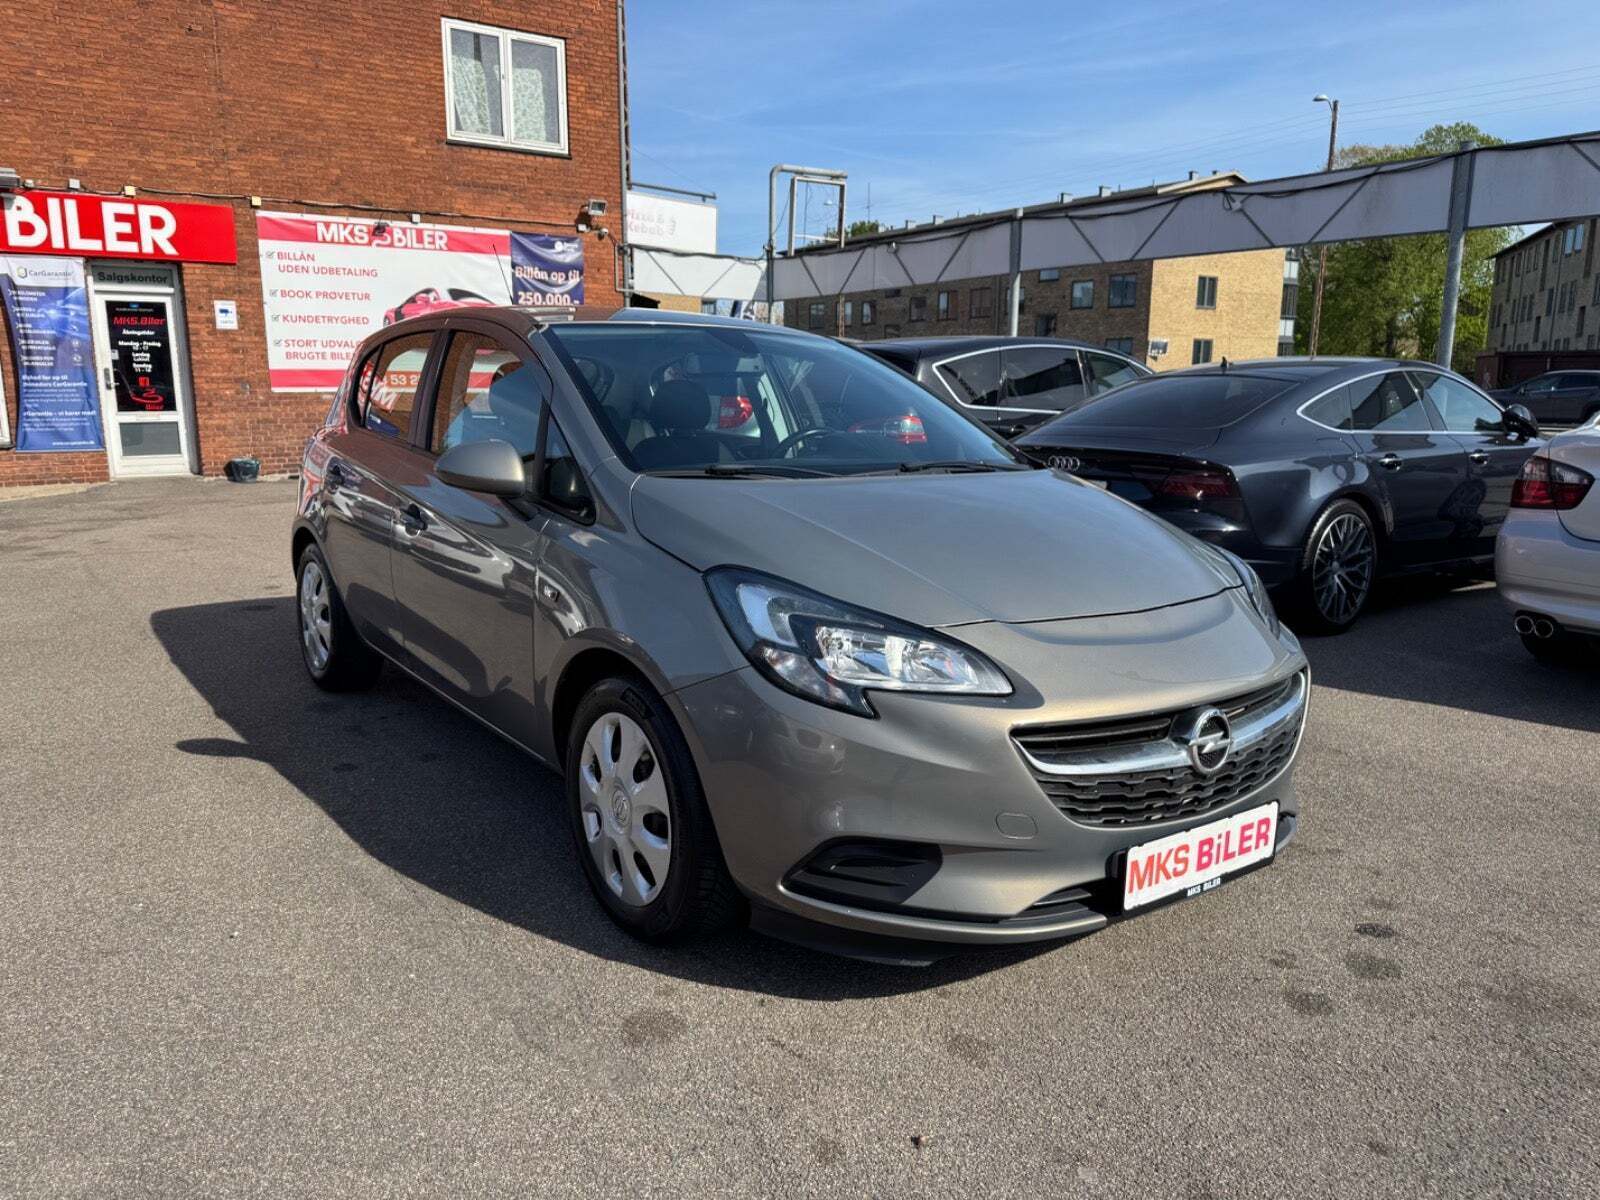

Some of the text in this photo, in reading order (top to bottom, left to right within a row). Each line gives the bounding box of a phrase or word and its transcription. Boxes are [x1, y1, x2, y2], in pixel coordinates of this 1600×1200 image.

[4, 195, 179, 256] BILER
[316, 222, 448, 250] MKS BILER
[278, 263, 378, 278] UDEN UDBETALING
[515, 265, 581, 285] Billån op til
[97, 271, 169, 284] Salgskontor
[280, 290, 371, 301] BOOK PRØVETUR
[282, 314, 370, 325] KUNDETRYGHED
[284, 338, 317, 349] STORT
[286, 351, 328, 360] BRUGTE
[390, 374, 406, 385] 53
[1128, 817, 1271, 894] MKS BiLER
[1187, 884, 1201, 897] MKS
